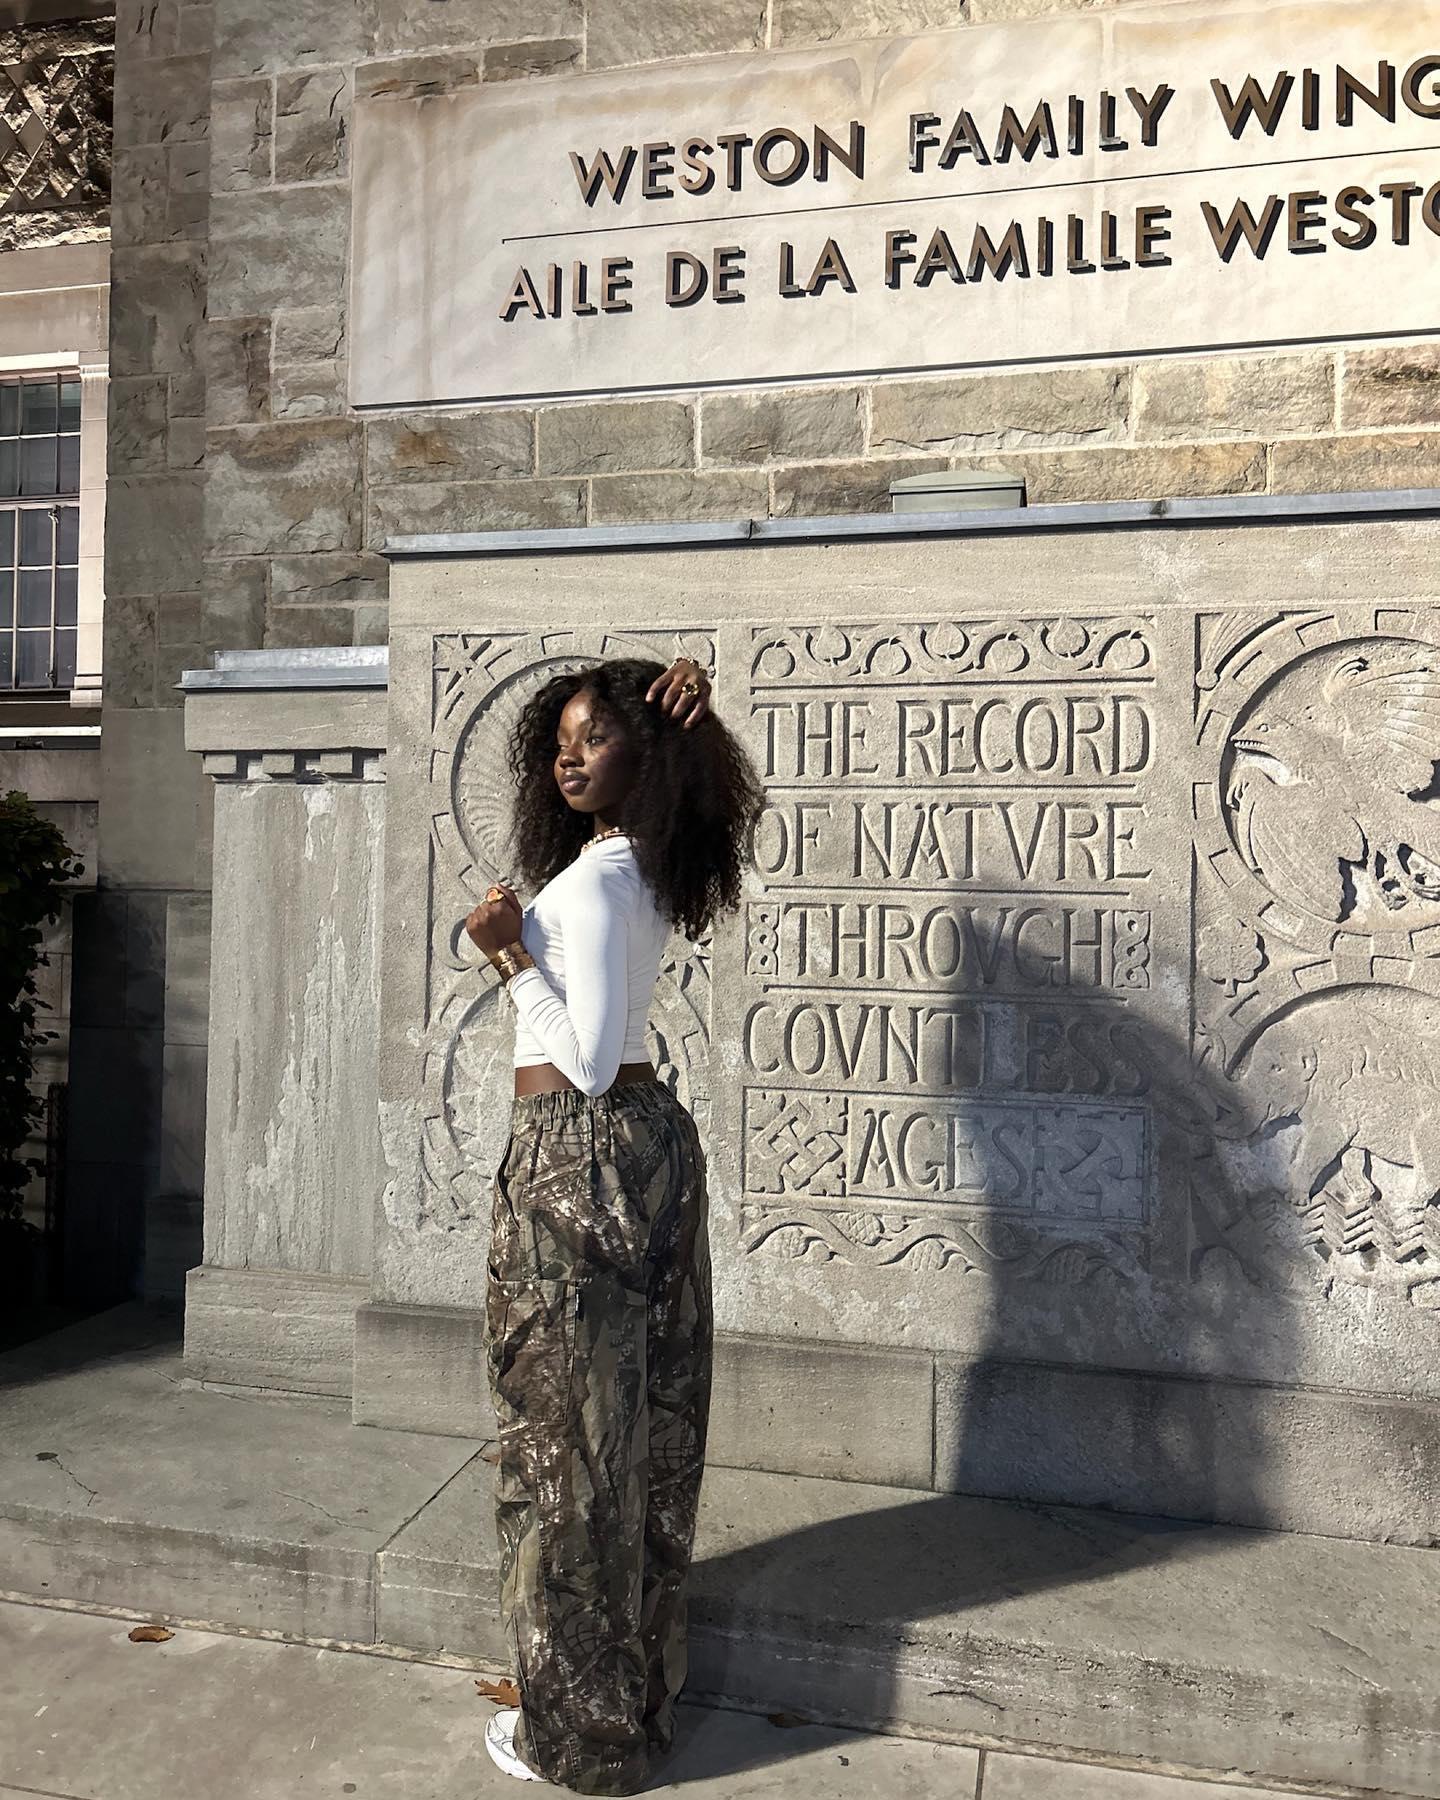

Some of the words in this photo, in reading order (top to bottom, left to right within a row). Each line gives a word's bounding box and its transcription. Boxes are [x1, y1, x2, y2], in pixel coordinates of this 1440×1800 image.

[568, 120, 865, 207] WESTON
[908, 83, 1176, 173] FAMILY
[498, 255, 633, 322] AILE
[665, 245, 746, 307] DE
[778, 236, 857, 298] LA
[884, 205, 1172, 290] FAMILLE
[749, 701, 879, 777] THE
[896, 695, 1155, 778] RECORD
[753, 801, 832, 878] OF
[853, 800, 1153, 881] NATVRE
[784, 902, 1113, 987] THROVGH
[743, 999, 1151, 1098] COVNTLESS
[852, 1107, 1032, 1200] AGES
